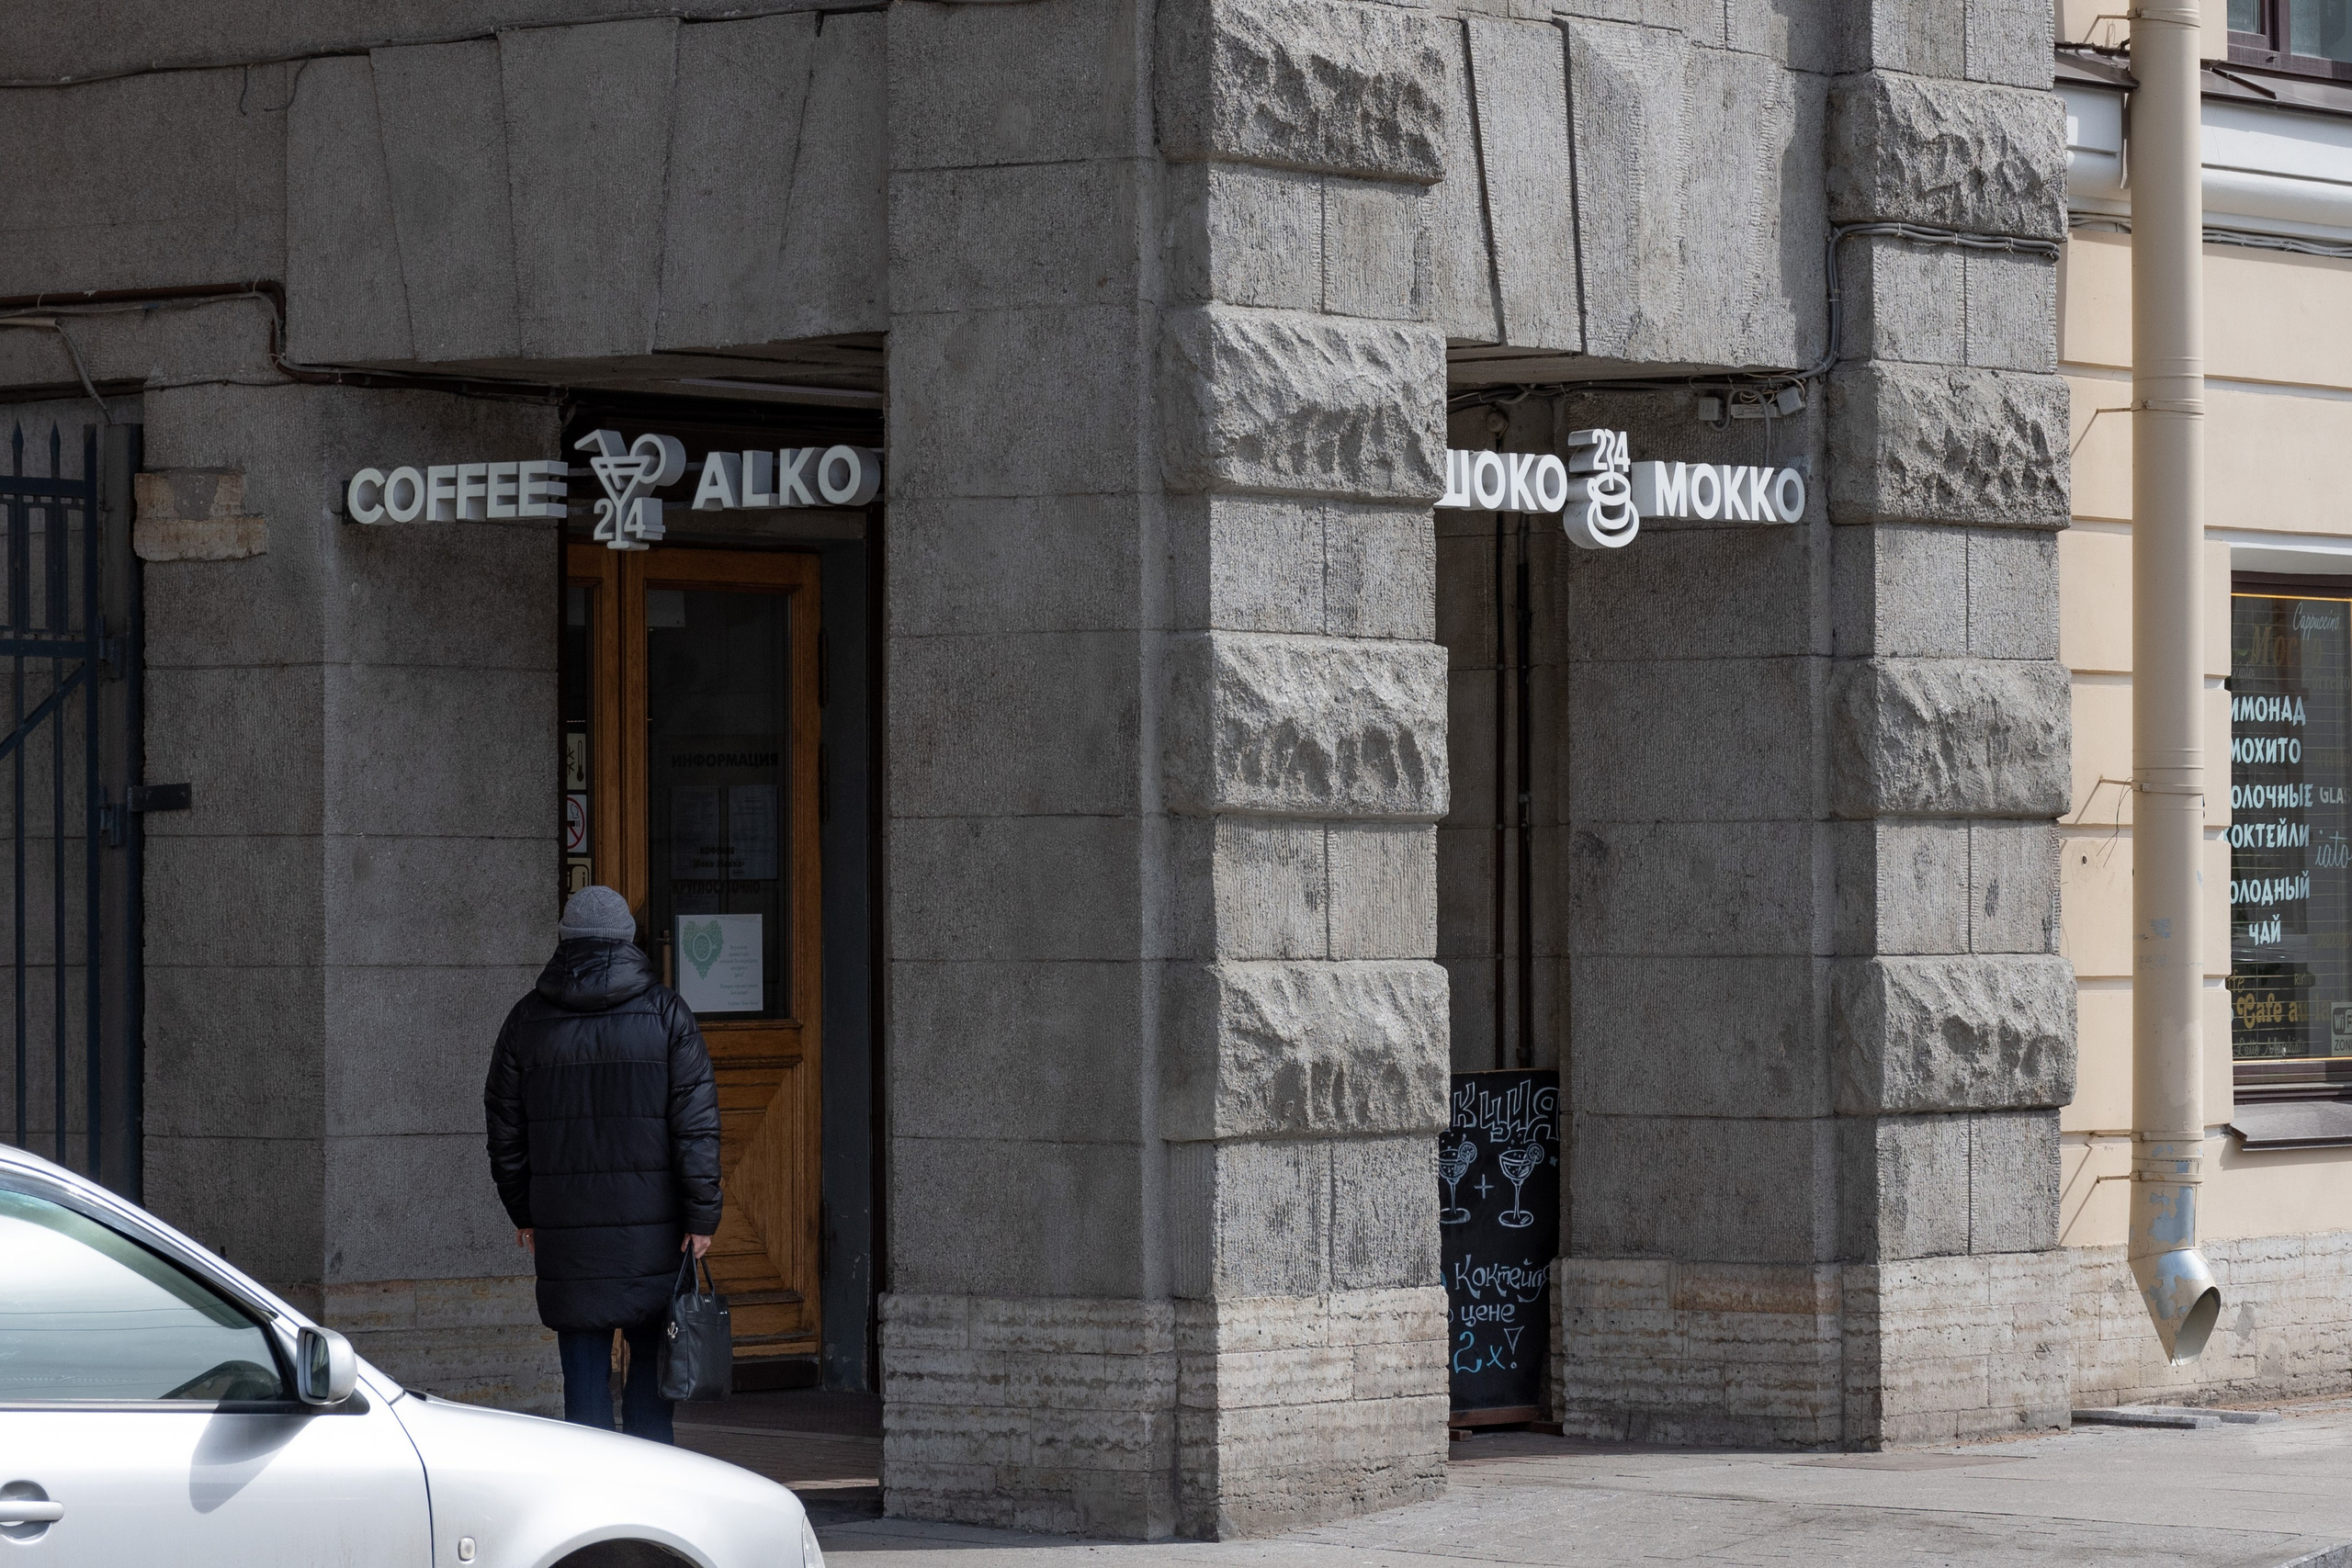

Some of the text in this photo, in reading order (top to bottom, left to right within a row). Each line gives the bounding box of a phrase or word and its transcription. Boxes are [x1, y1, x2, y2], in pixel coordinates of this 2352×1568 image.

[1589, 429, 1631, 472] 24
[347, 460, 568, 525] COFFEE
[692, 445, 879, 511] ALKO
[1655, 461, 1805, 523] МОККО
[594, 498, 650, 541] 24
[2293, 603, 2340, 640] Cappuccino
[2231, 695, 2306, 726] ИМОНАД
[672, 752, 779, 769] ИНФОРМАЦИЯ
[2231, 783, 2314, 809] ОЛОЧНЫЕ
[2230, 871, 2310, 907] ОЛОДНЫЙ
[2248, 914, 2281, 946] ЧАЙ
[2227, 969, 2245, 993] ffe
[2236, 993, 2282, 1029] Cafe
[1461, 1303, 1516, 1327] цене
